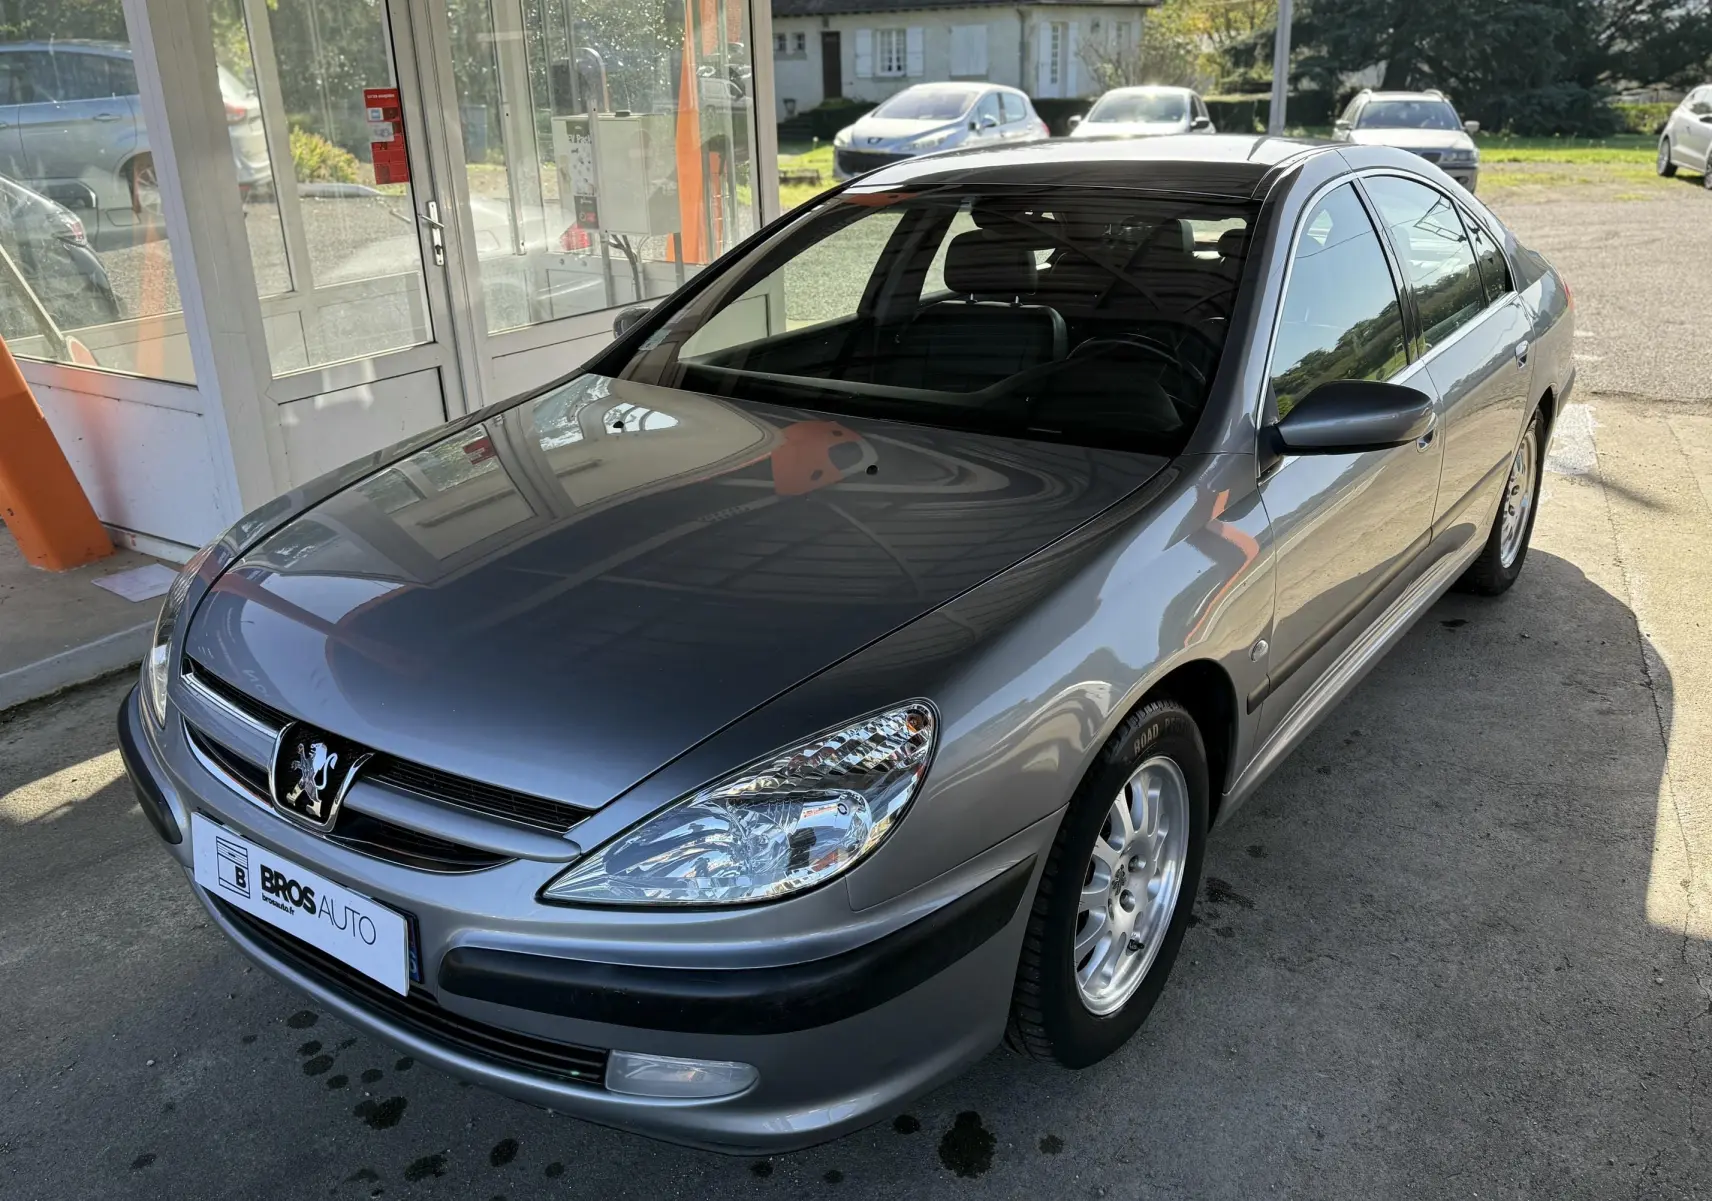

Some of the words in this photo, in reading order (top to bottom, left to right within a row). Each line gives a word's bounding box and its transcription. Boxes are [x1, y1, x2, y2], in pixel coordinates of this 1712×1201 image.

[1133, 723, 1159, 756] ROAD
[235, 865, 246, 888] B
[260, 864, 316, 915] BROS
[318, 895, 377, 945] AUTO
[261, 892, 295, 915] brosauto.fr
